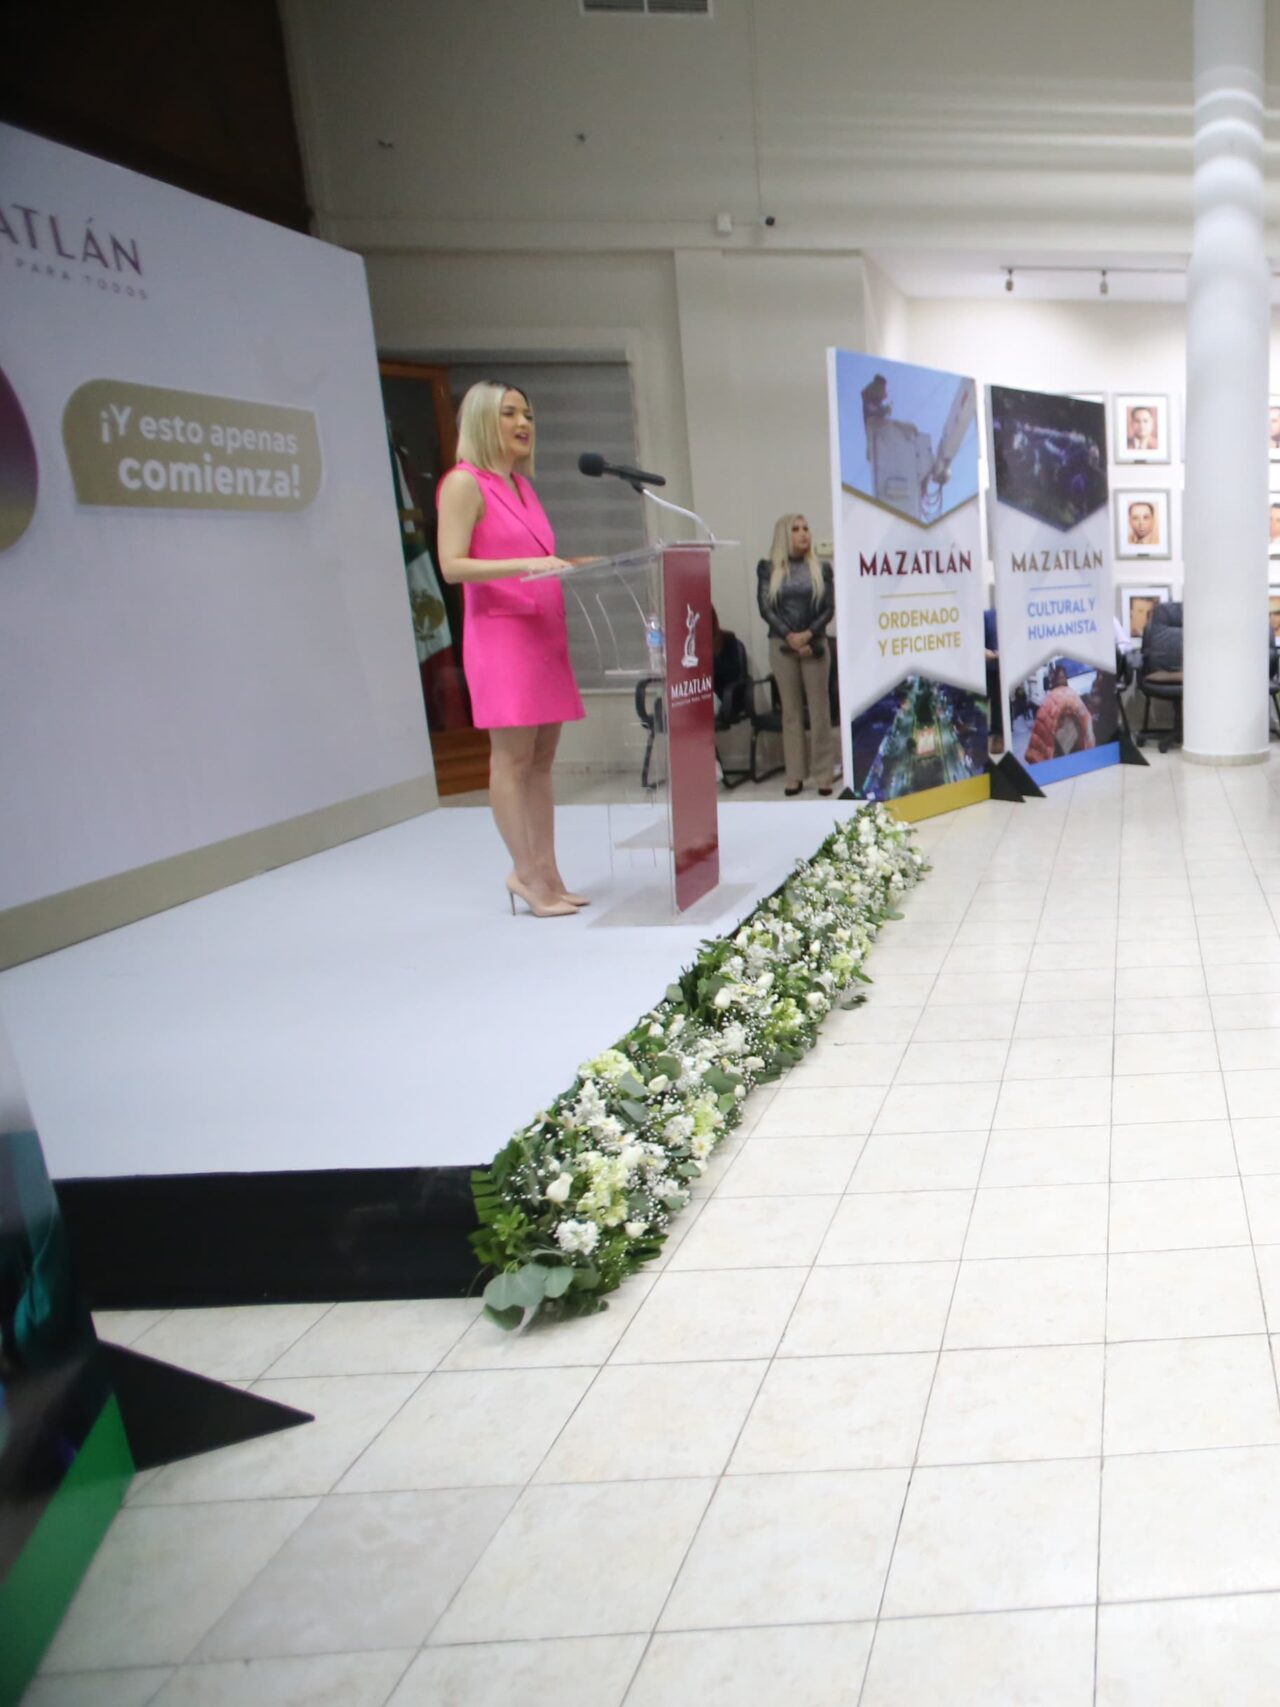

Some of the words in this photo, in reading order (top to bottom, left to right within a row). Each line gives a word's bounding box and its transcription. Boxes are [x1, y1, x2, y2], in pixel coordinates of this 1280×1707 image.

[101, 403, 132, 443] ¡Y
[139, 415, 204, 444] esto
[210, 424, 297, 454] apenas
[118, 453, 301, 500] comienza!
[859, 543, 972, 576] MAZATLÁN
[1011, 542, 1103, 573] MAZATLÁN
[878, 607, 960, 630] ORDENADO
[1028, 599, 1086, 617] CULTURAL
[1087, 597, 1096, 611] Y
[1028, 620, 1097, 641] HUMANISTA
[878, 639, 889, 656] Y
[892, 631, 962, 655] EFICIENTE
[671, 674, 711, 698] MAZATLÁN
